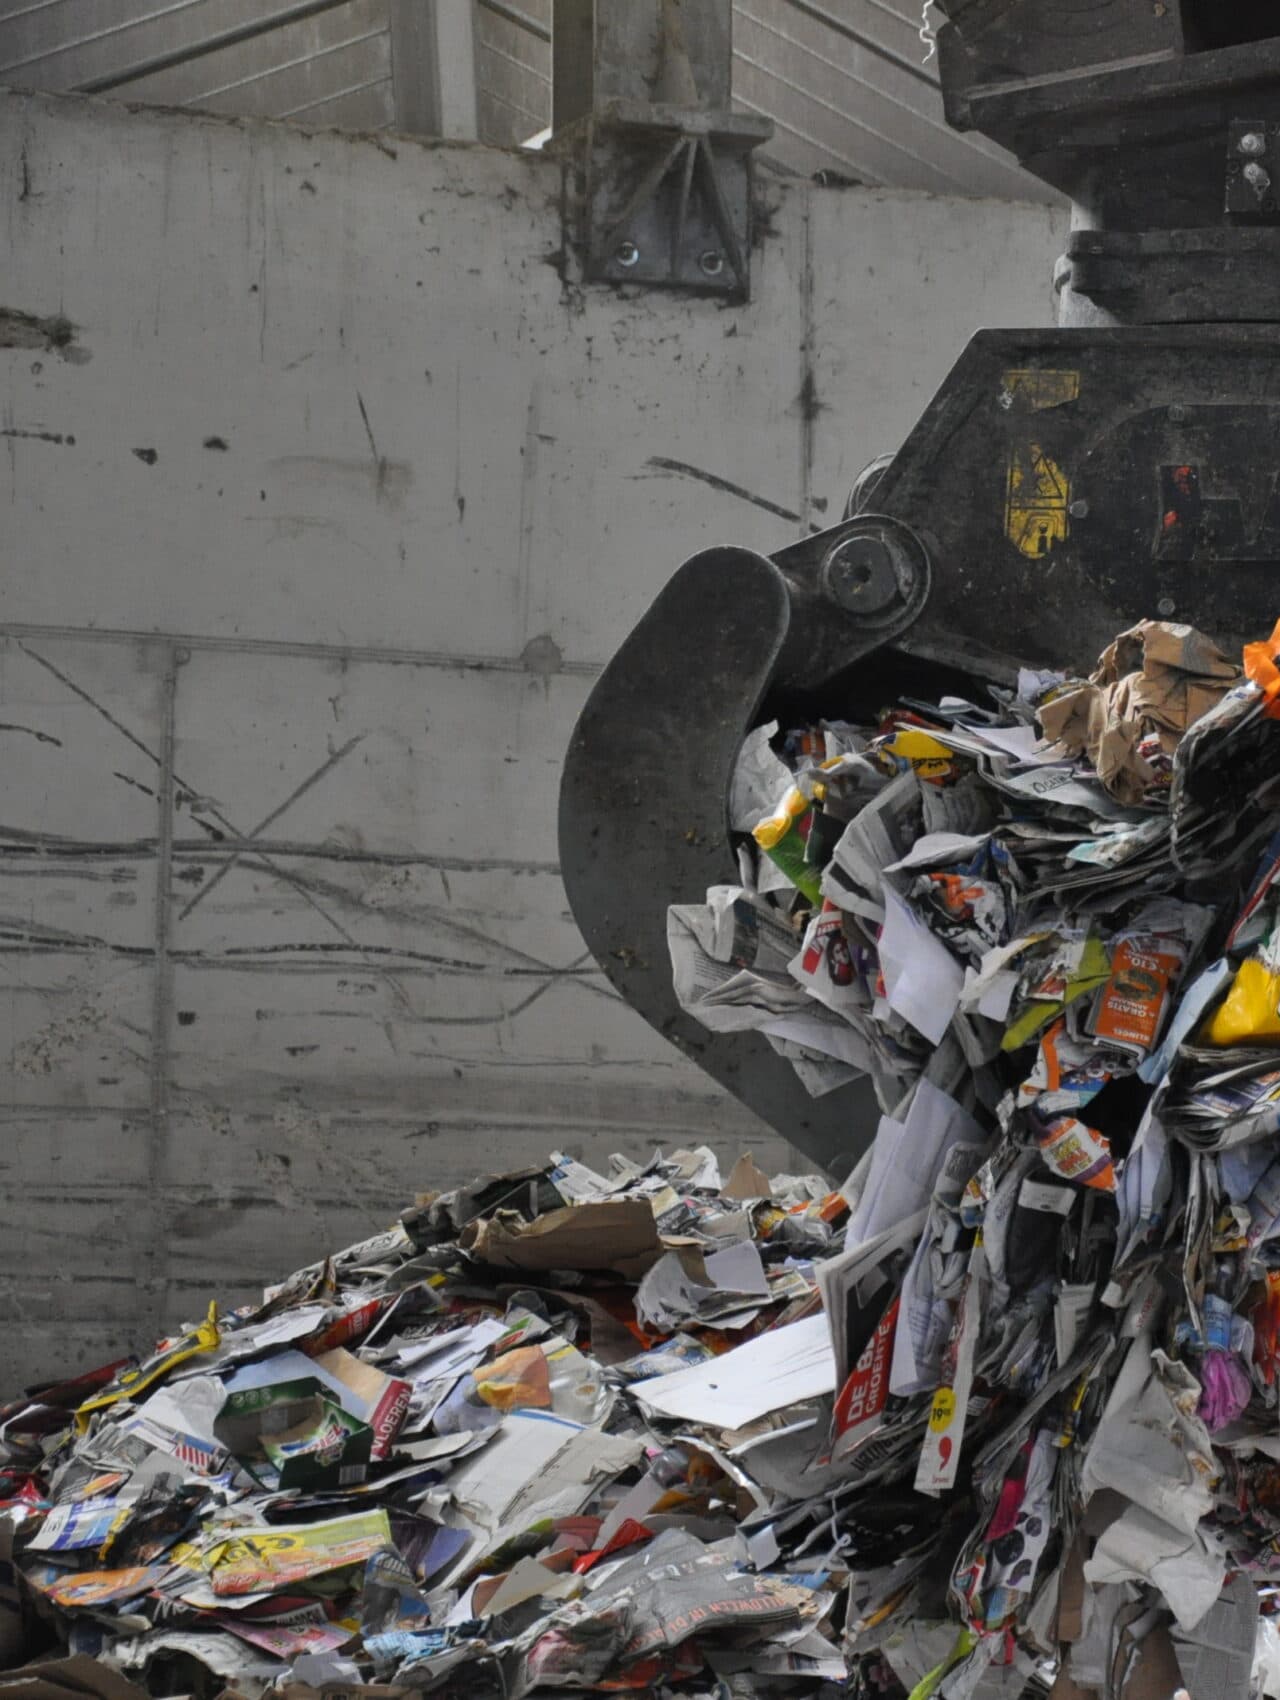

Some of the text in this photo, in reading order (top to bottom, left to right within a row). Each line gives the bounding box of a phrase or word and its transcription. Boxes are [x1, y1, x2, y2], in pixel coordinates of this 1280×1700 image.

[866, 1321, 891, 1414] GROENTE
[371, 1387, 411, 1452] VLOEREN
[847, 1382, 868, 1424] DE
